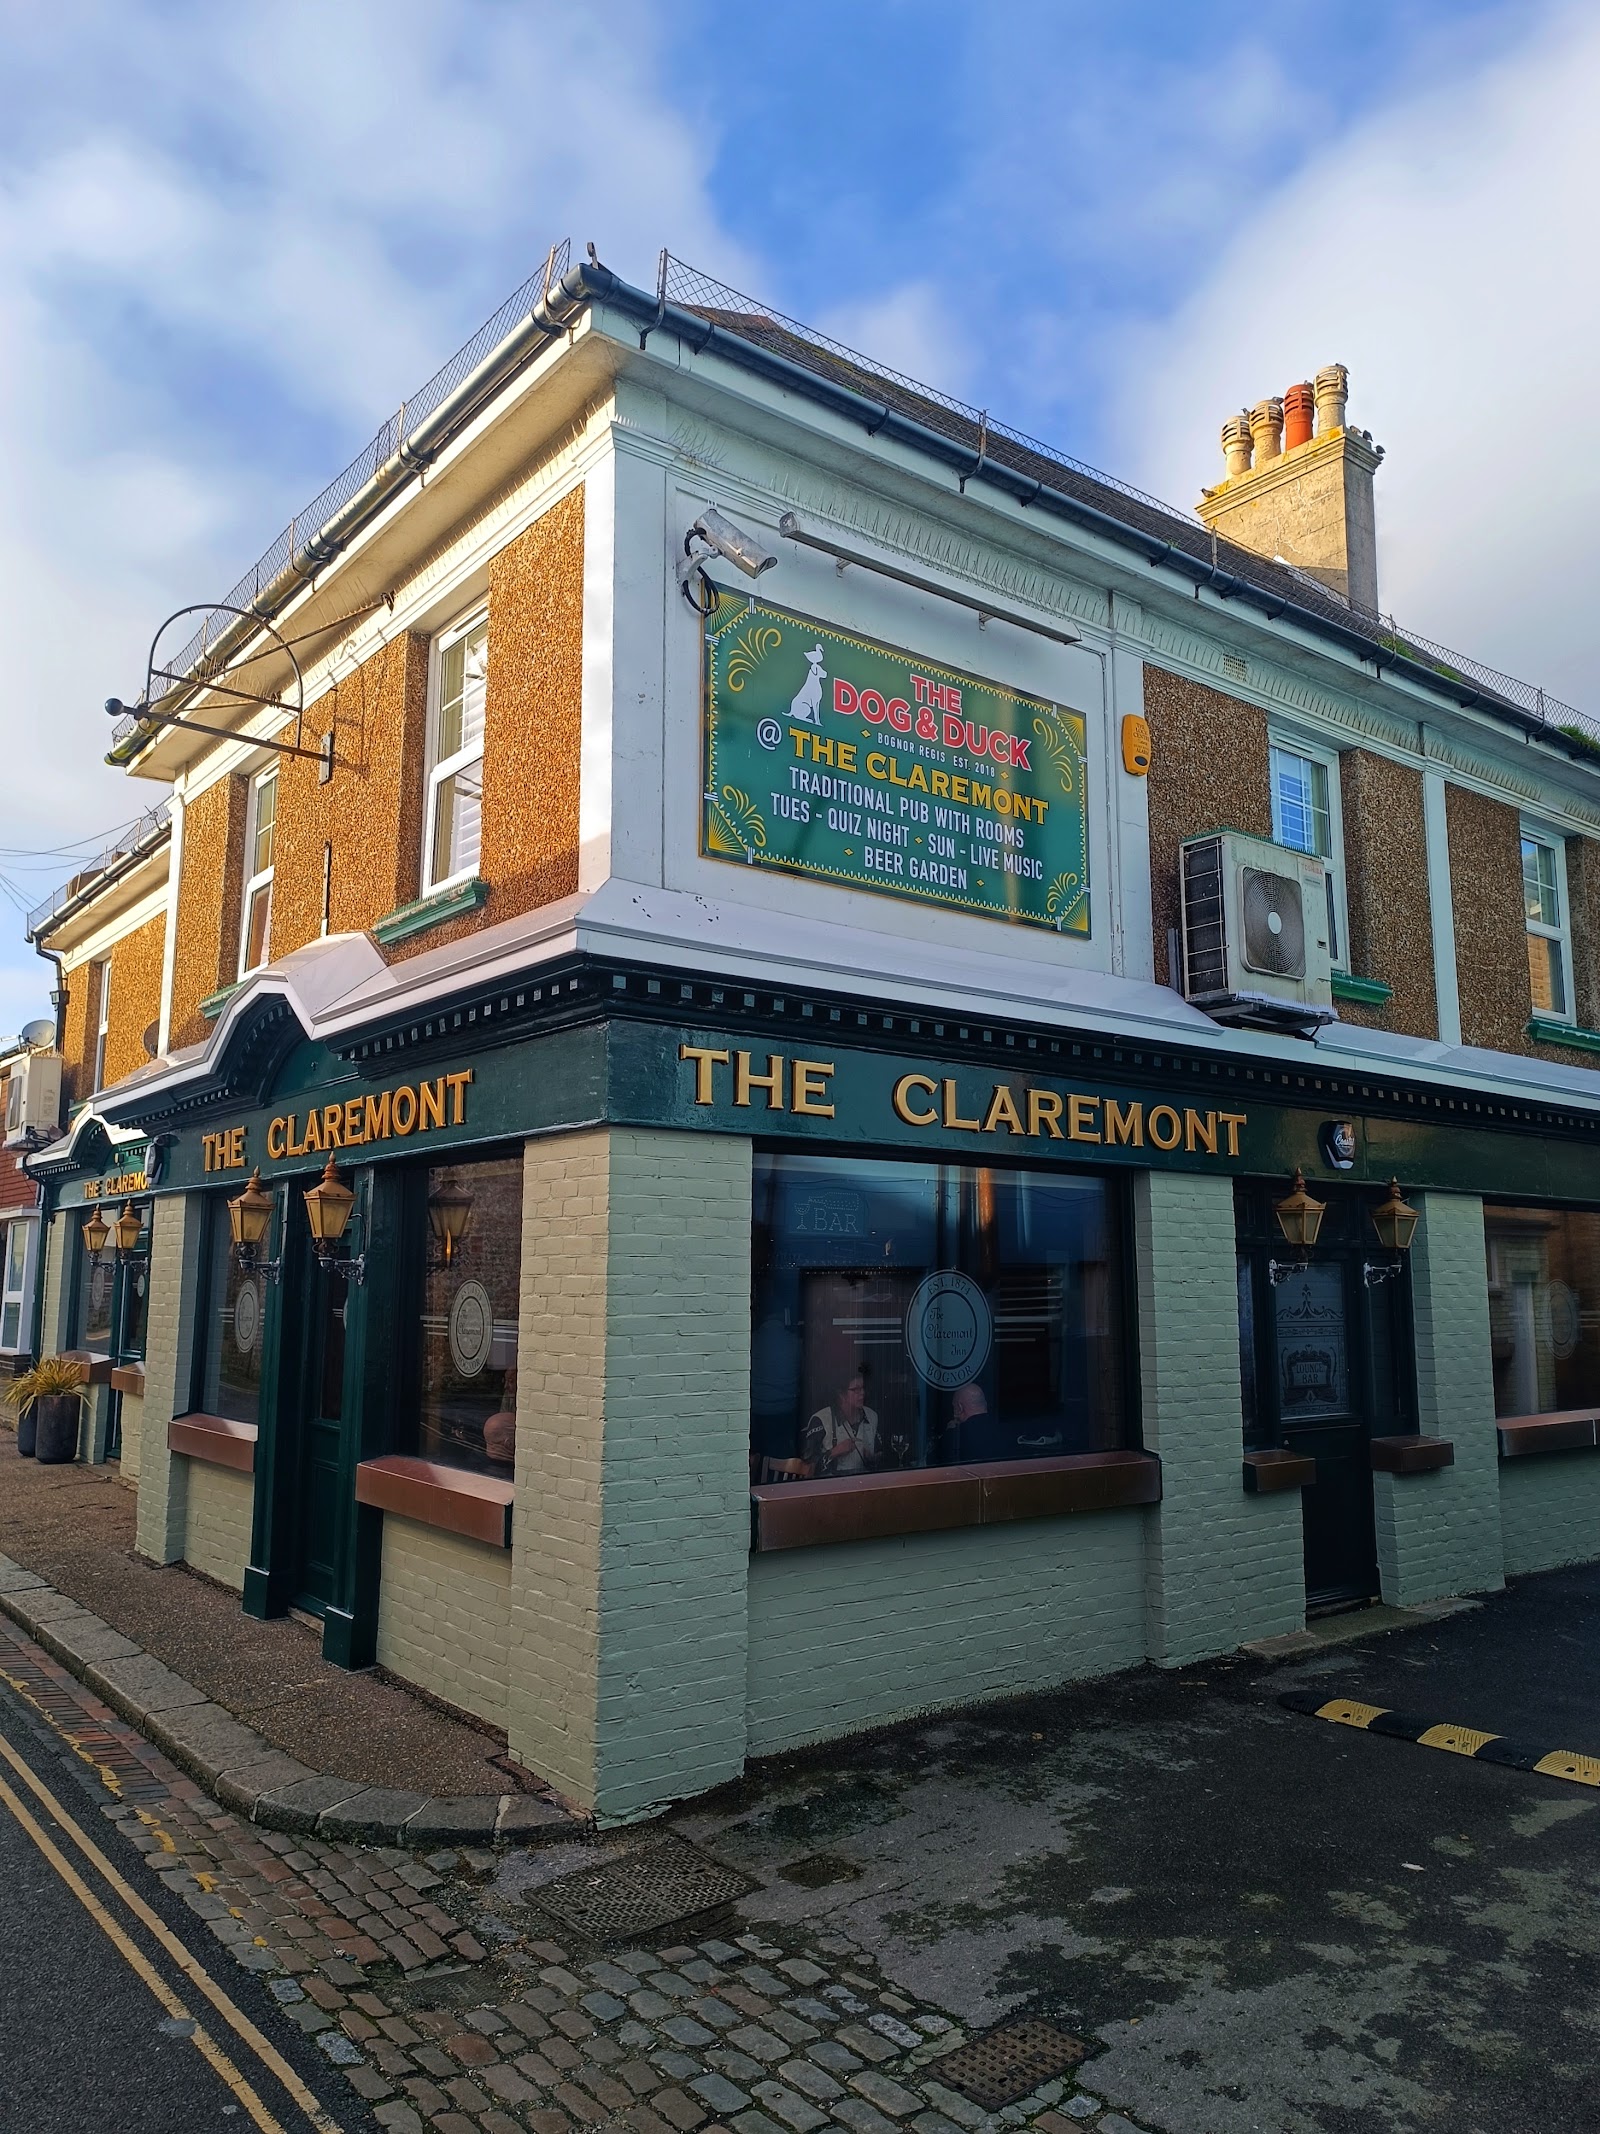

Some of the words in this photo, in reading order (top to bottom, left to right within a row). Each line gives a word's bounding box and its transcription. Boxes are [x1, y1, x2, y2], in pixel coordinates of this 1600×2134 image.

[910, 674, 962, 716] THE
[756, 718, 782, 750] @
[788, 726, 858, 773] THE
[866, 752, 1049, 825] CLAREMONT
[878, 732, 915, 753] BOGNOR
[919, 745, 946, 763] REGIS
[953, 756, 971, 771] EST.
[975, 762, 995, 778] 2018
[789, 766, 894, 815] TRADITIONAL
[900, 796, 929, 824] PUB
[935, 806, 970, 835] WITH
[975, 817, 1024, 849] ROOMS
[770, 792, 810, 823] TUES
[828, 807, 862, 836] QUIZ
[867, 816, 910, 848] NIGHT
[928, 833, 955, 860] SUN
[970, 843, 1000, 870] LIVE
[1003, 851, 1043, 881] MUSIC
[864, 845, 904, 876] BEER
[909, 857, 968, 890] GARDEN
[202, 1125, 248, 1172] THE
[267, 1068, 474, 1160] CLAREMONT
[679, 1043, 835, 1119] THE
[893, 1073, 1247, 1158] CLAREMONT
[84, 1180, 101, 1199] THE
[105, 1171, 150, 1196] CLAREMO
[813, 1207, 859, 1233] BAR
[925, 1324, 973, 1339] Claremont
[930, 1307, 944, 1320] The
[926, 1364, 973, 1383] BOGNOR
[1302, 1374, 1318, 1384] BAR
